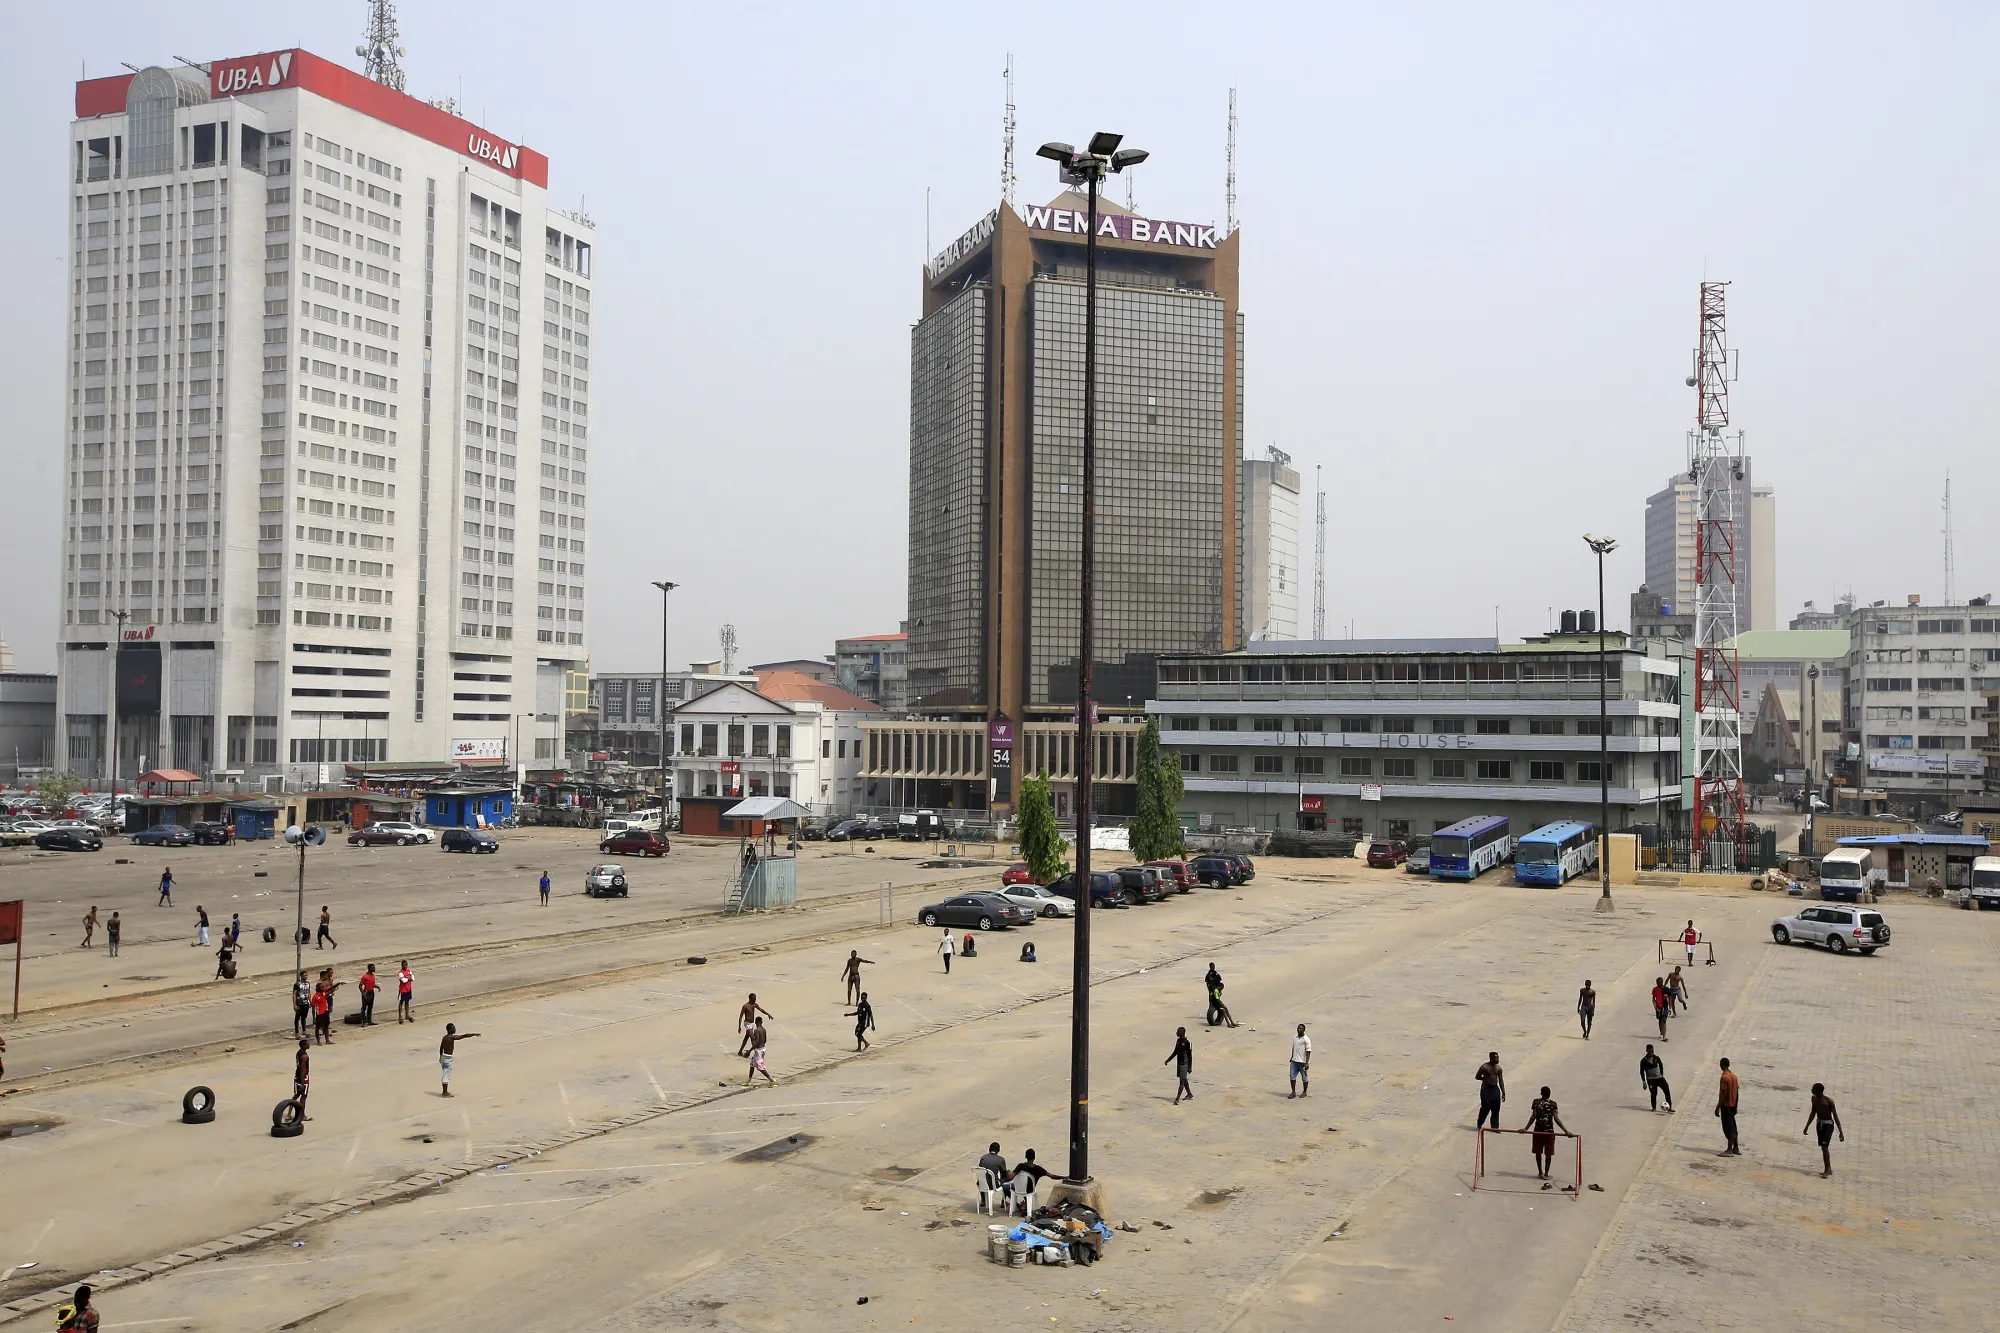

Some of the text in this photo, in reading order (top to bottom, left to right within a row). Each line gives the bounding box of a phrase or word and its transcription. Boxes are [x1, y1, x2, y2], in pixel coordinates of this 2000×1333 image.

[218, 66, 263, 92] UBA
[468, 134, 501, 165] UBA
[1025, 206, 1216, 249] WEMA BANK
[930, 210, 995, 280] WEMA BANK
[124, 630, 143, 640] UBA
[1379, 735, 1467, 748] HOUSE
[993, 749, 1010, 763] 54
